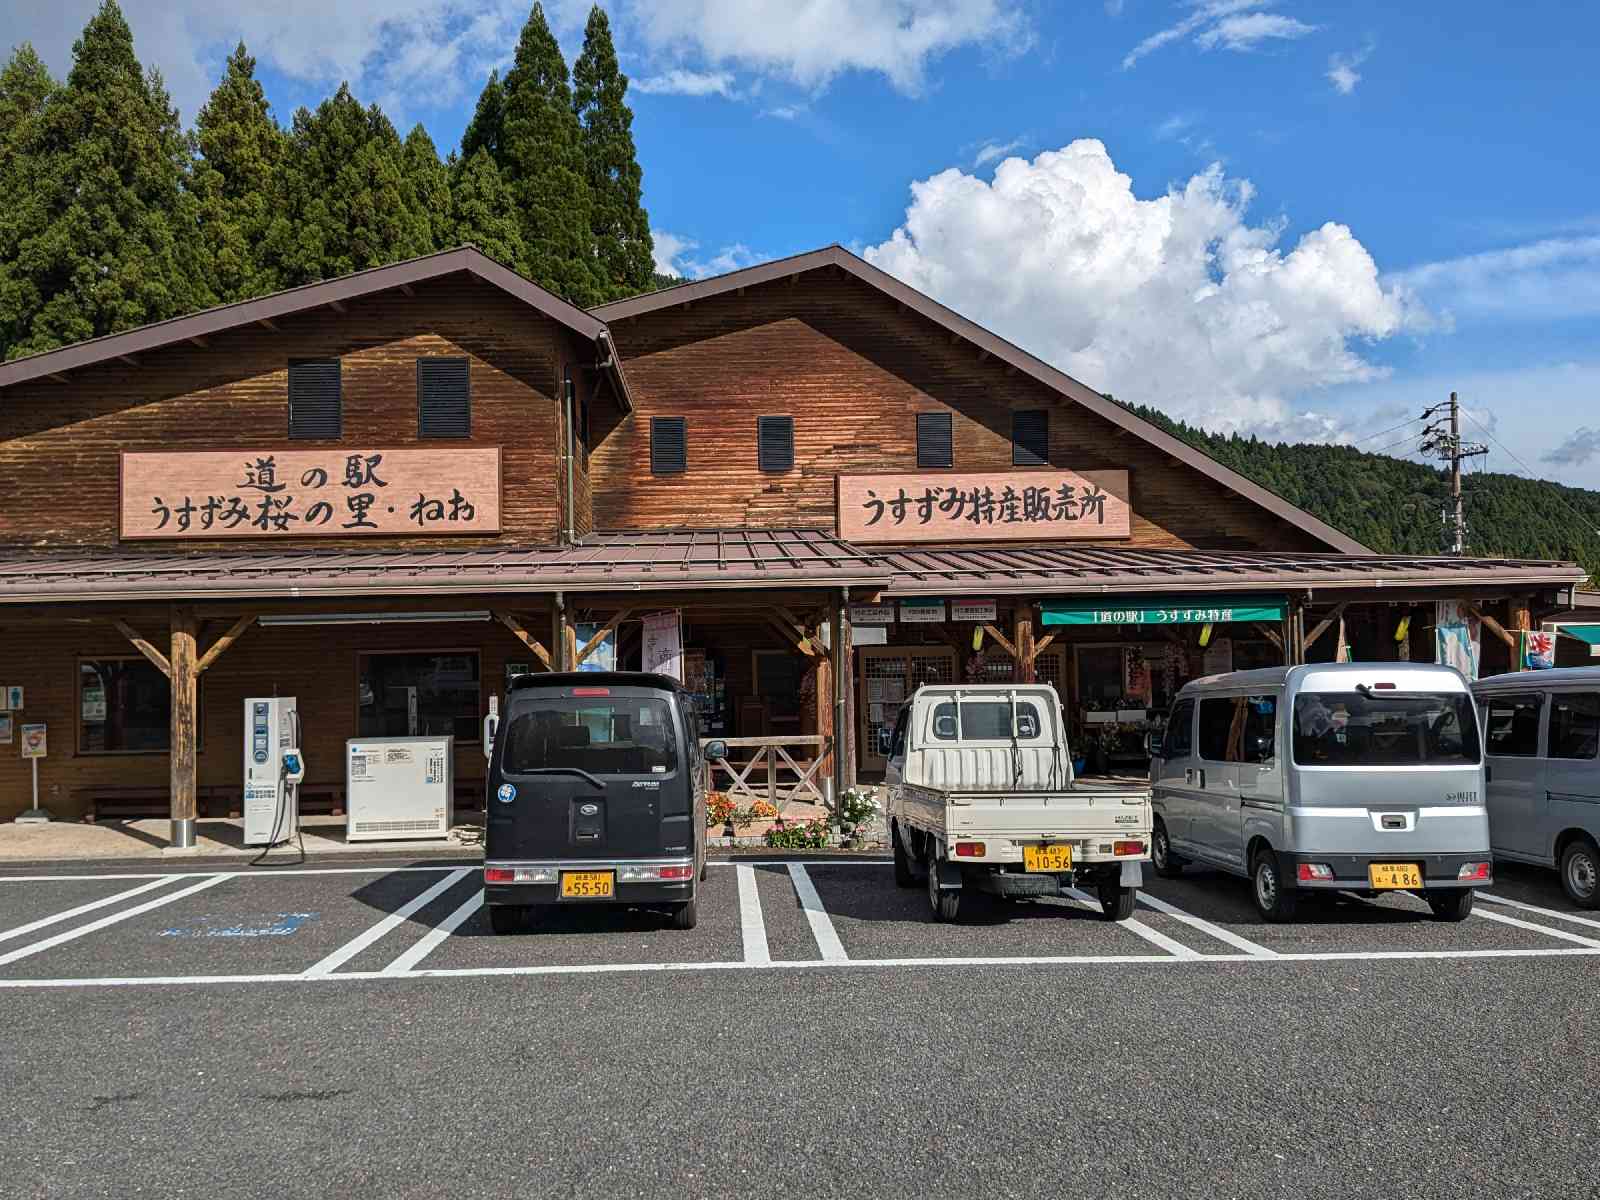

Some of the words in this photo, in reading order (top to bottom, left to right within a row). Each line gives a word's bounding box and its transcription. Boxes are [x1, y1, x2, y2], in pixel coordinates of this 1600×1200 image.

[236, 453, 388, 490] 道の駅
[151, 488, 476, 532] うすずみ桜の里・ねお
[862, 482, 1108, 526] うすずみ特産販売所
[1036, 855, 1070, 869] 10-56
[573, 881, 609, 895] 55-50
